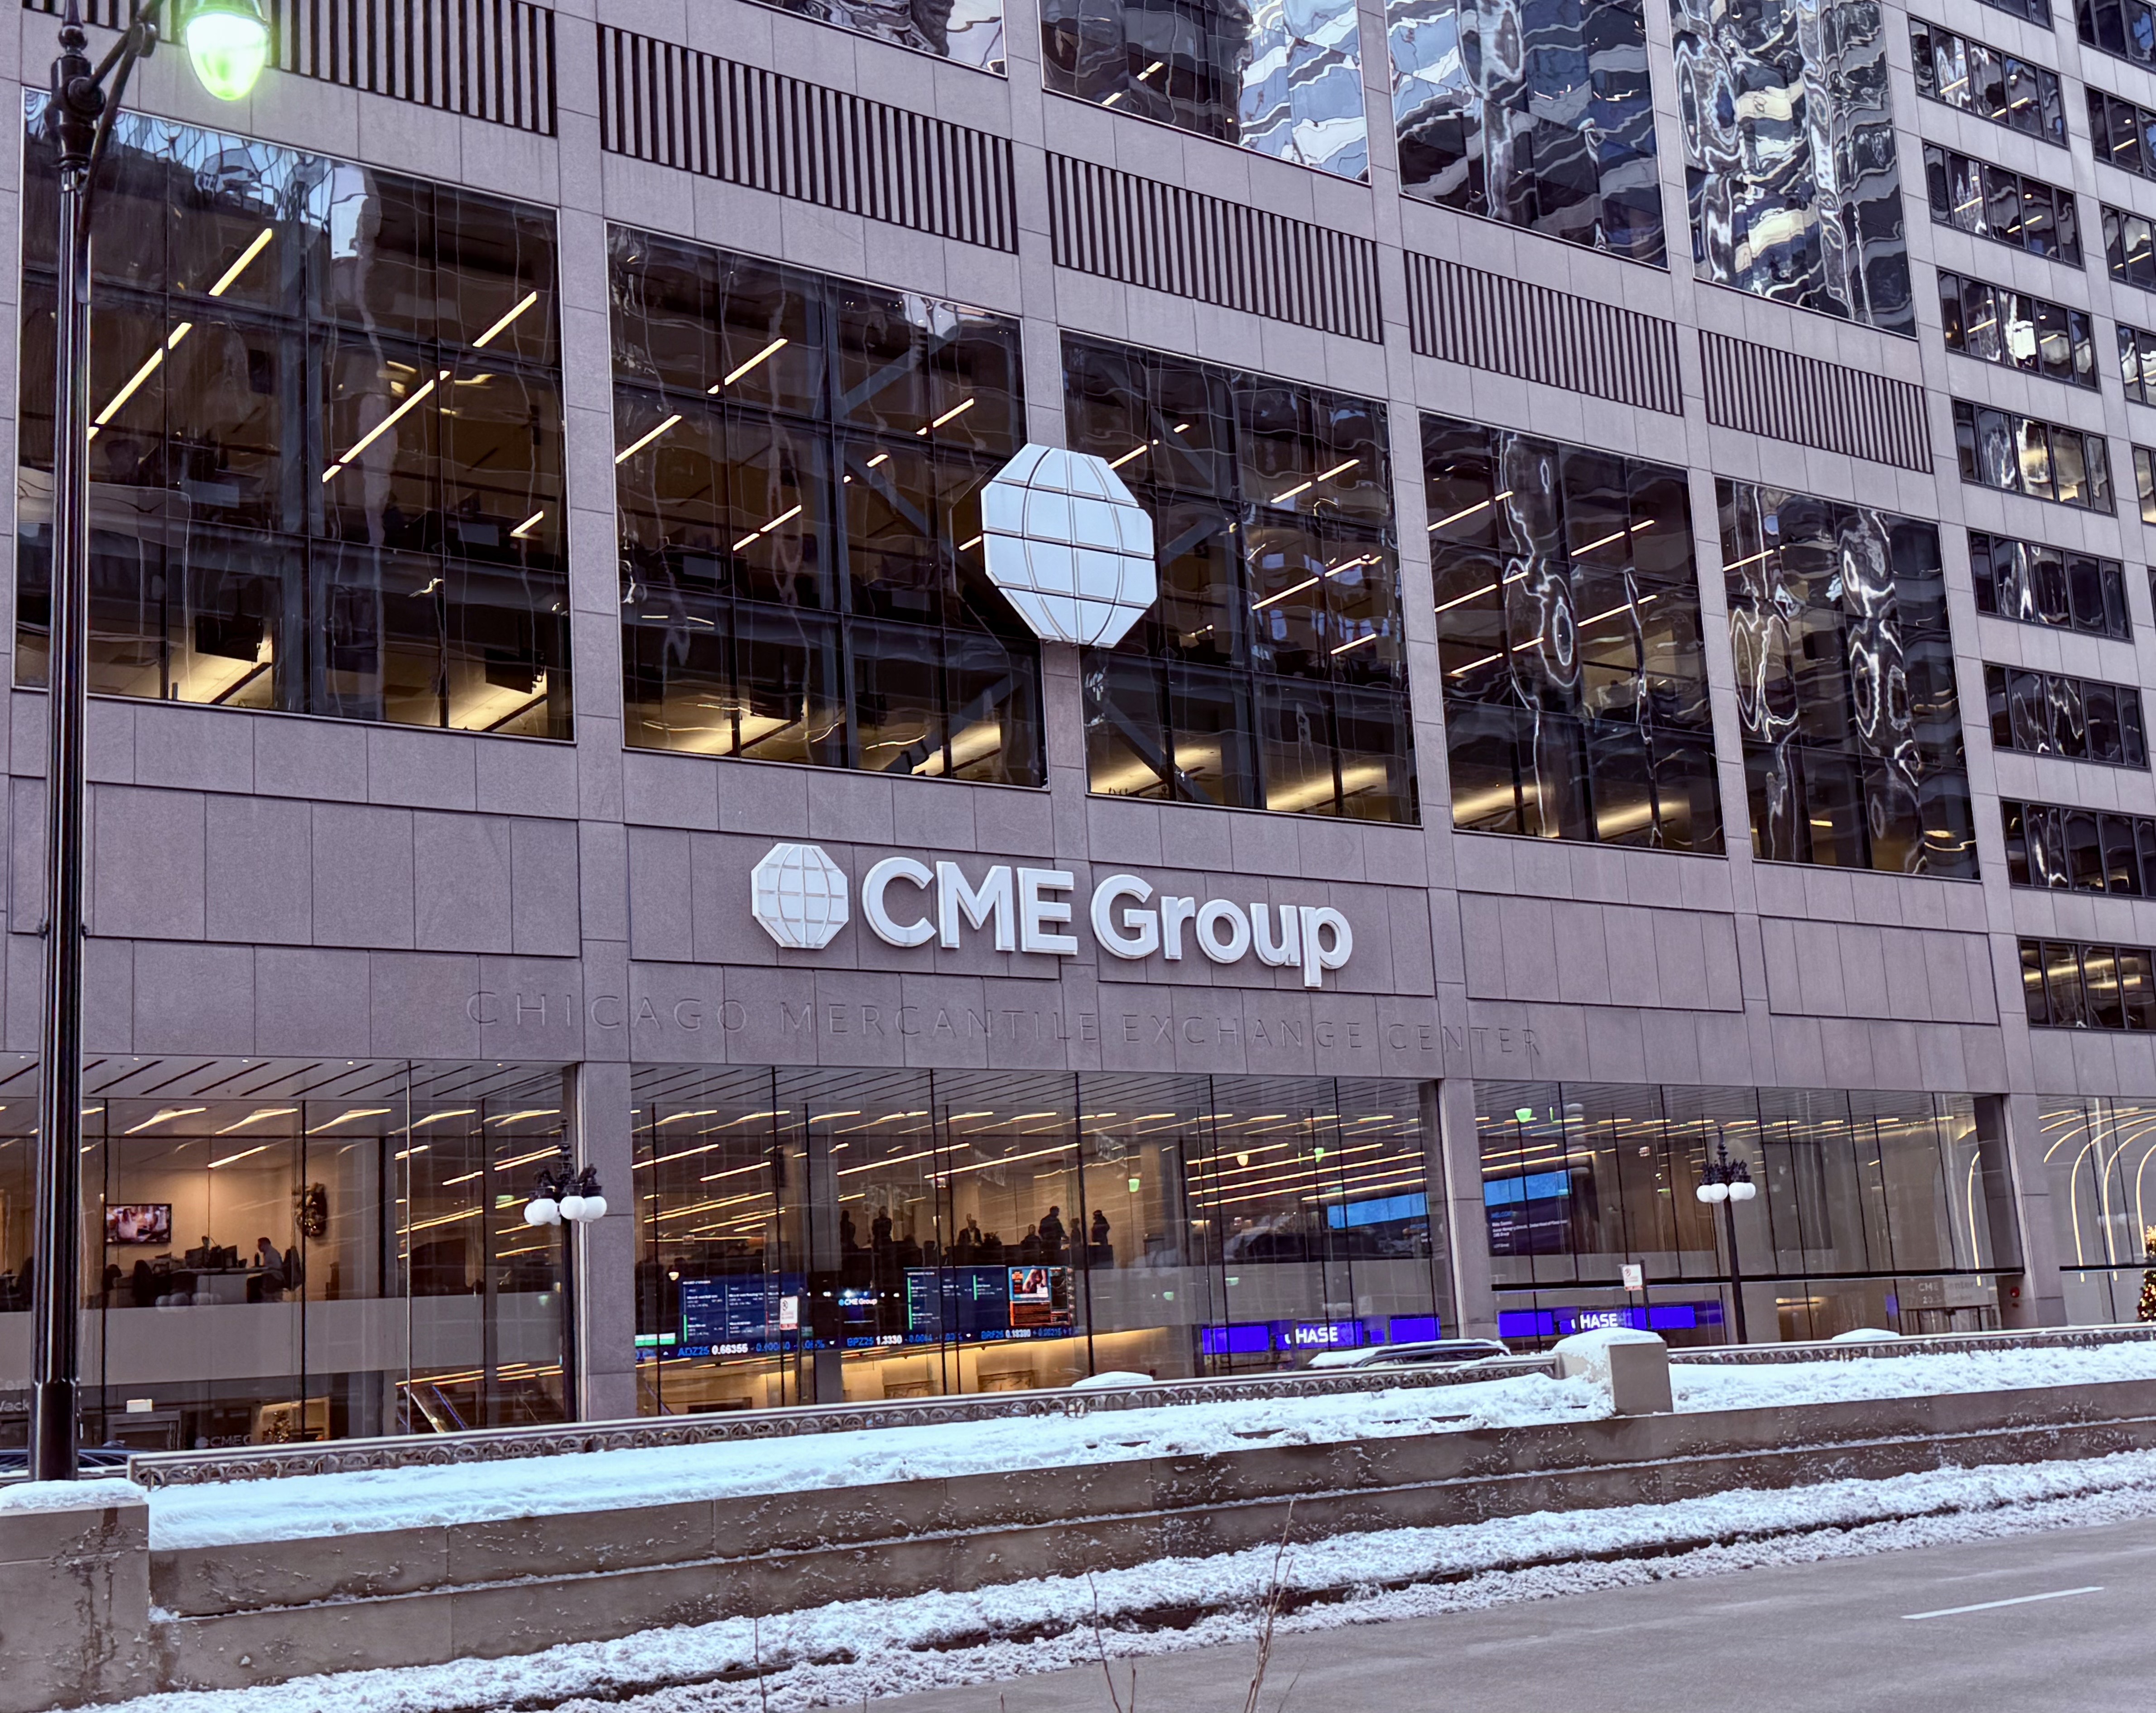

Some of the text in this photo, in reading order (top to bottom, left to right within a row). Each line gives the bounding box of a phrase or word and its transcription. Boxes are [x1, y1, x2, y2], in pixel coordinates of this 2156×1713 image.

[862, 857, 1353, 988] CME Group
[466, 991, 1541, 1056] CHICAGO MERCANTILE EXCHANGE CENTER
[1571, 1312, 1618, 1329] HASE
[1285, 1326, 1338, 1344] HASE
[210, 1435, 242, 1447] CME
